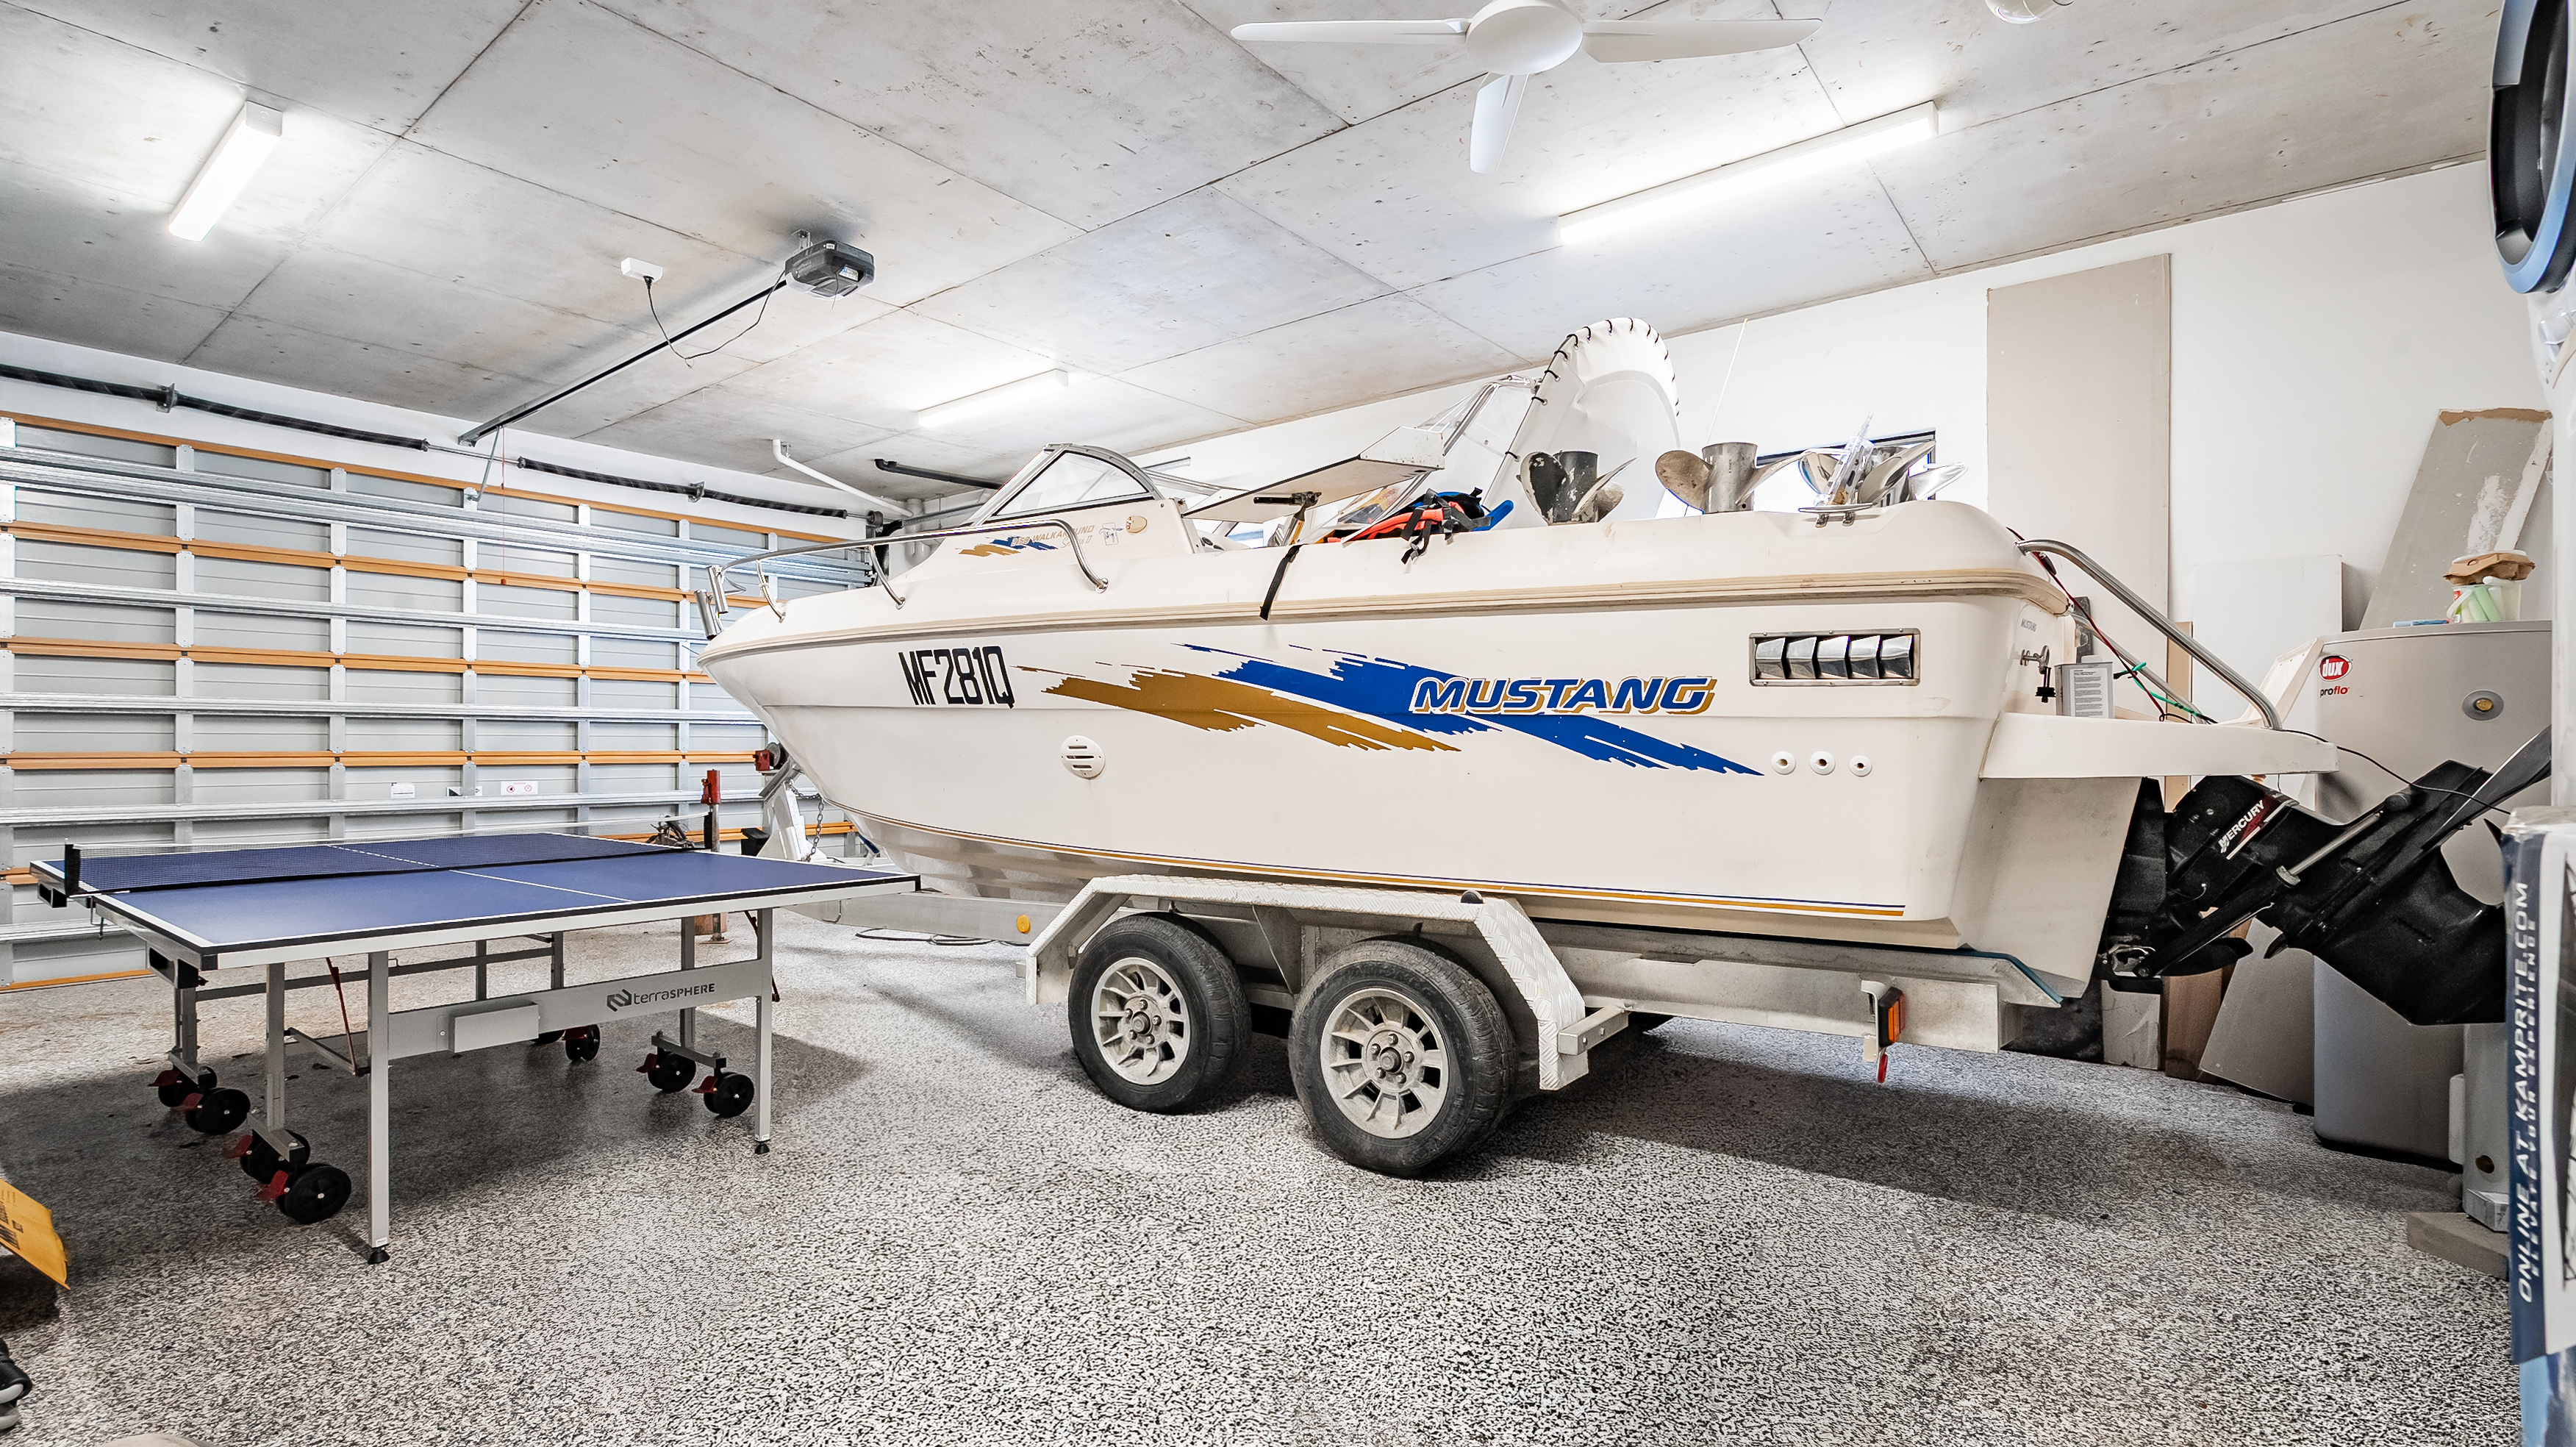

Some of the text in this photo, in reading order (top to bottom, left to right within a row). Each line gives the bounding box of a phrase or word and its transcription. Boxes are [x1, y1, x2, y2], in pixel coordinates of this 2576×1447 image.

[1033, 525, 1095, 542] WALKARUND
[898, 646, 1015, 709] MF281Q
[2322, 659, 2344, 676] dux
[1410, 676, 1717, 714] MUSTANG
[2319, 685, 2349, 698] proflo
[2218, 799, 2264, 853] MERCURY
[633, 982, 715, 1005] terraSPHERE
[2514, 882, 2532, 1303] ONLINE AT KAMPRITE.COM
